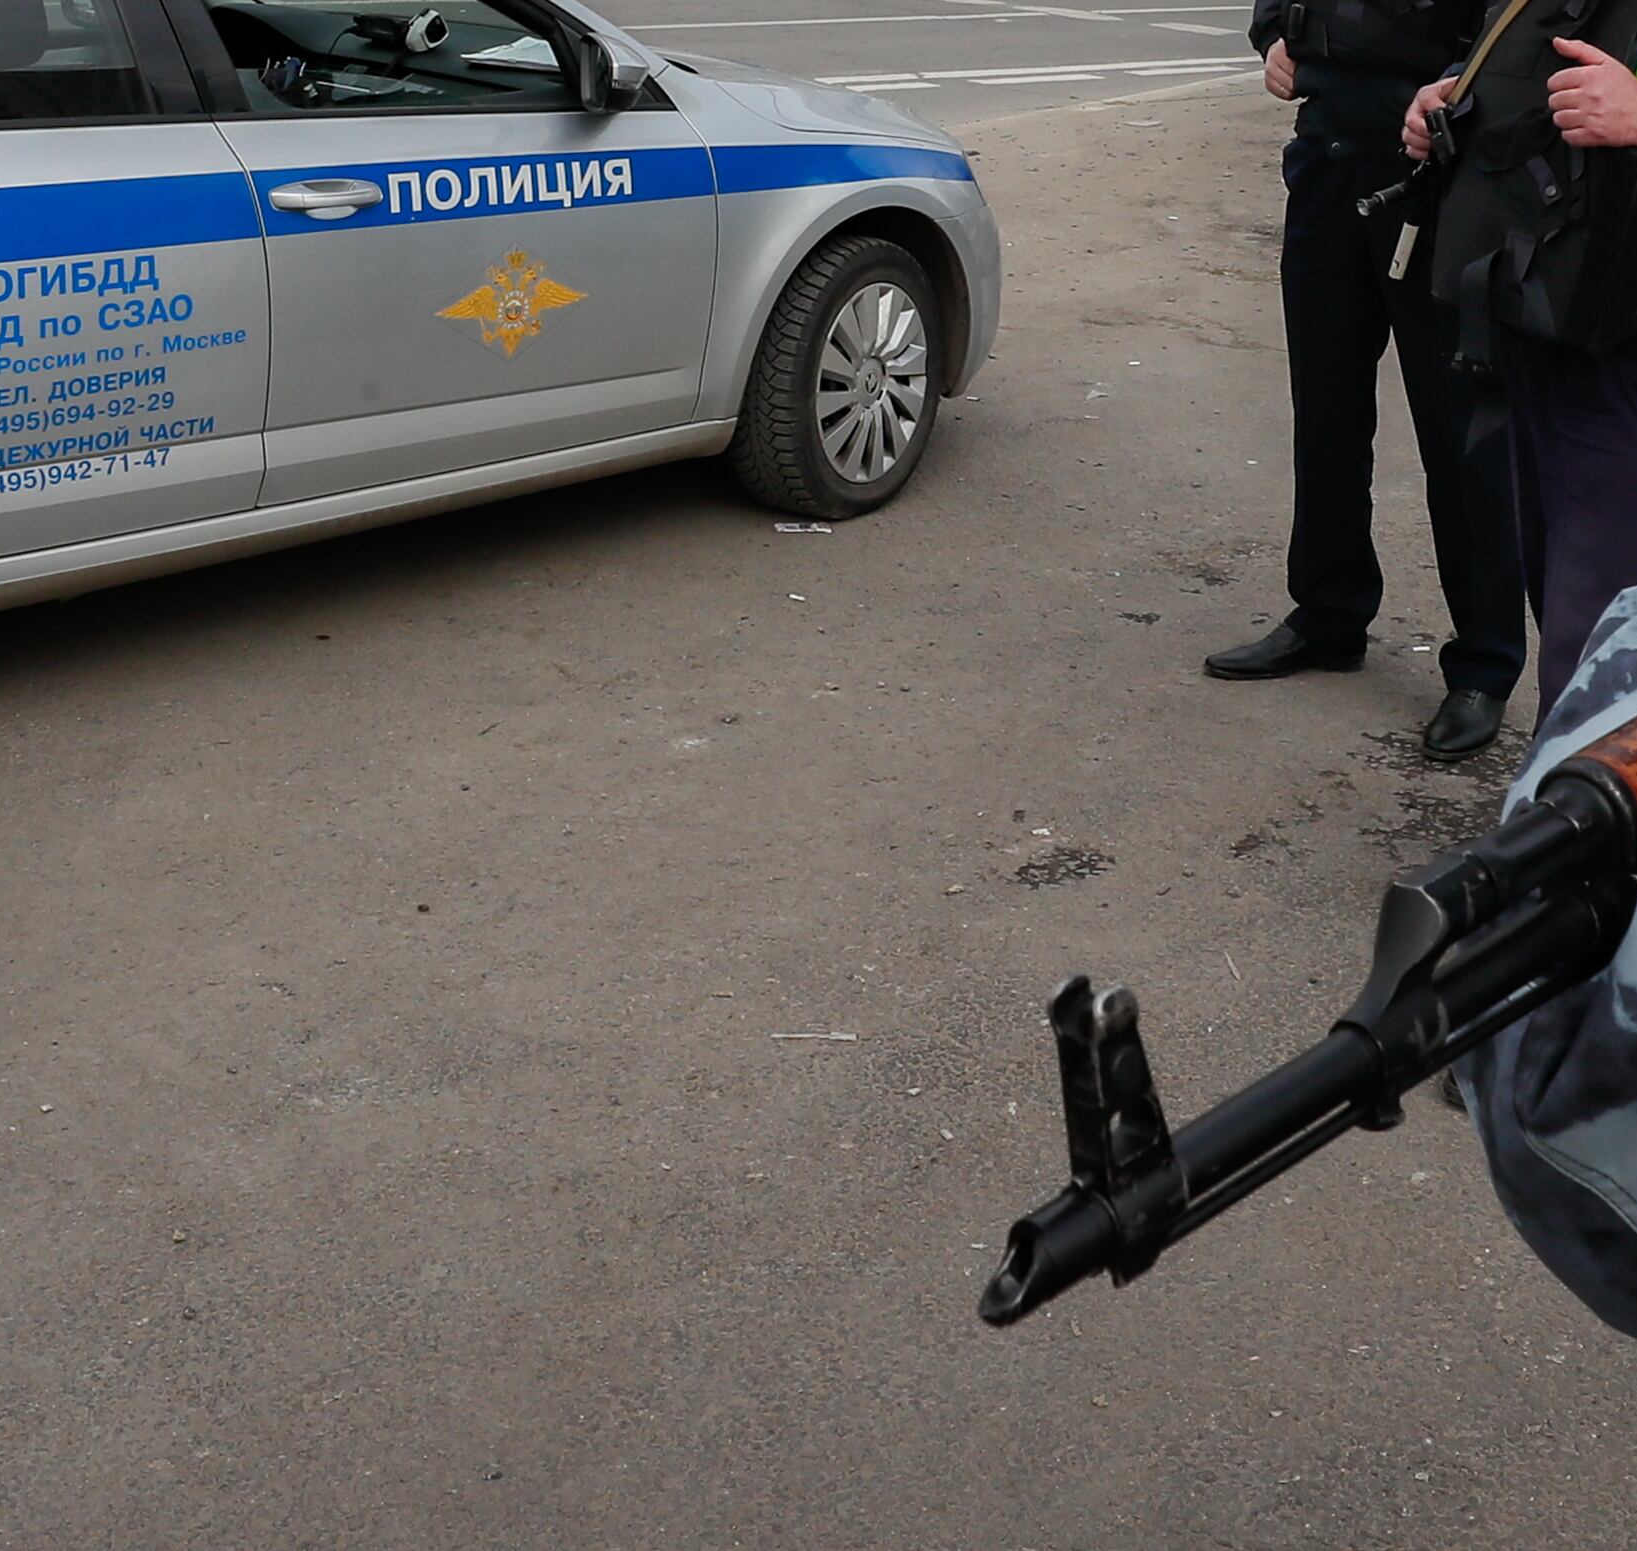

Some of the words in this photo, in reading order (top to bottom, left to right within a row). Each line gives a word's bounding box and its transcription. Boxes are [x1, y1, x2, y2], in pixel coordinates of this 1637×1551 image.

[387, 157, 634, 214] ПОЛИЦИЯ
[39, 314, 82, 339] по
[97, 293, 194, 332] СЗАО
[96, 346, 124, 364] по
[134, 342, 150, 359] г.
[162, 328, 247, 355] Москве
[48, 365, 167, 404] ДОВЕРИЯ
[140, 415, 214, 443] ЧАСТИ
